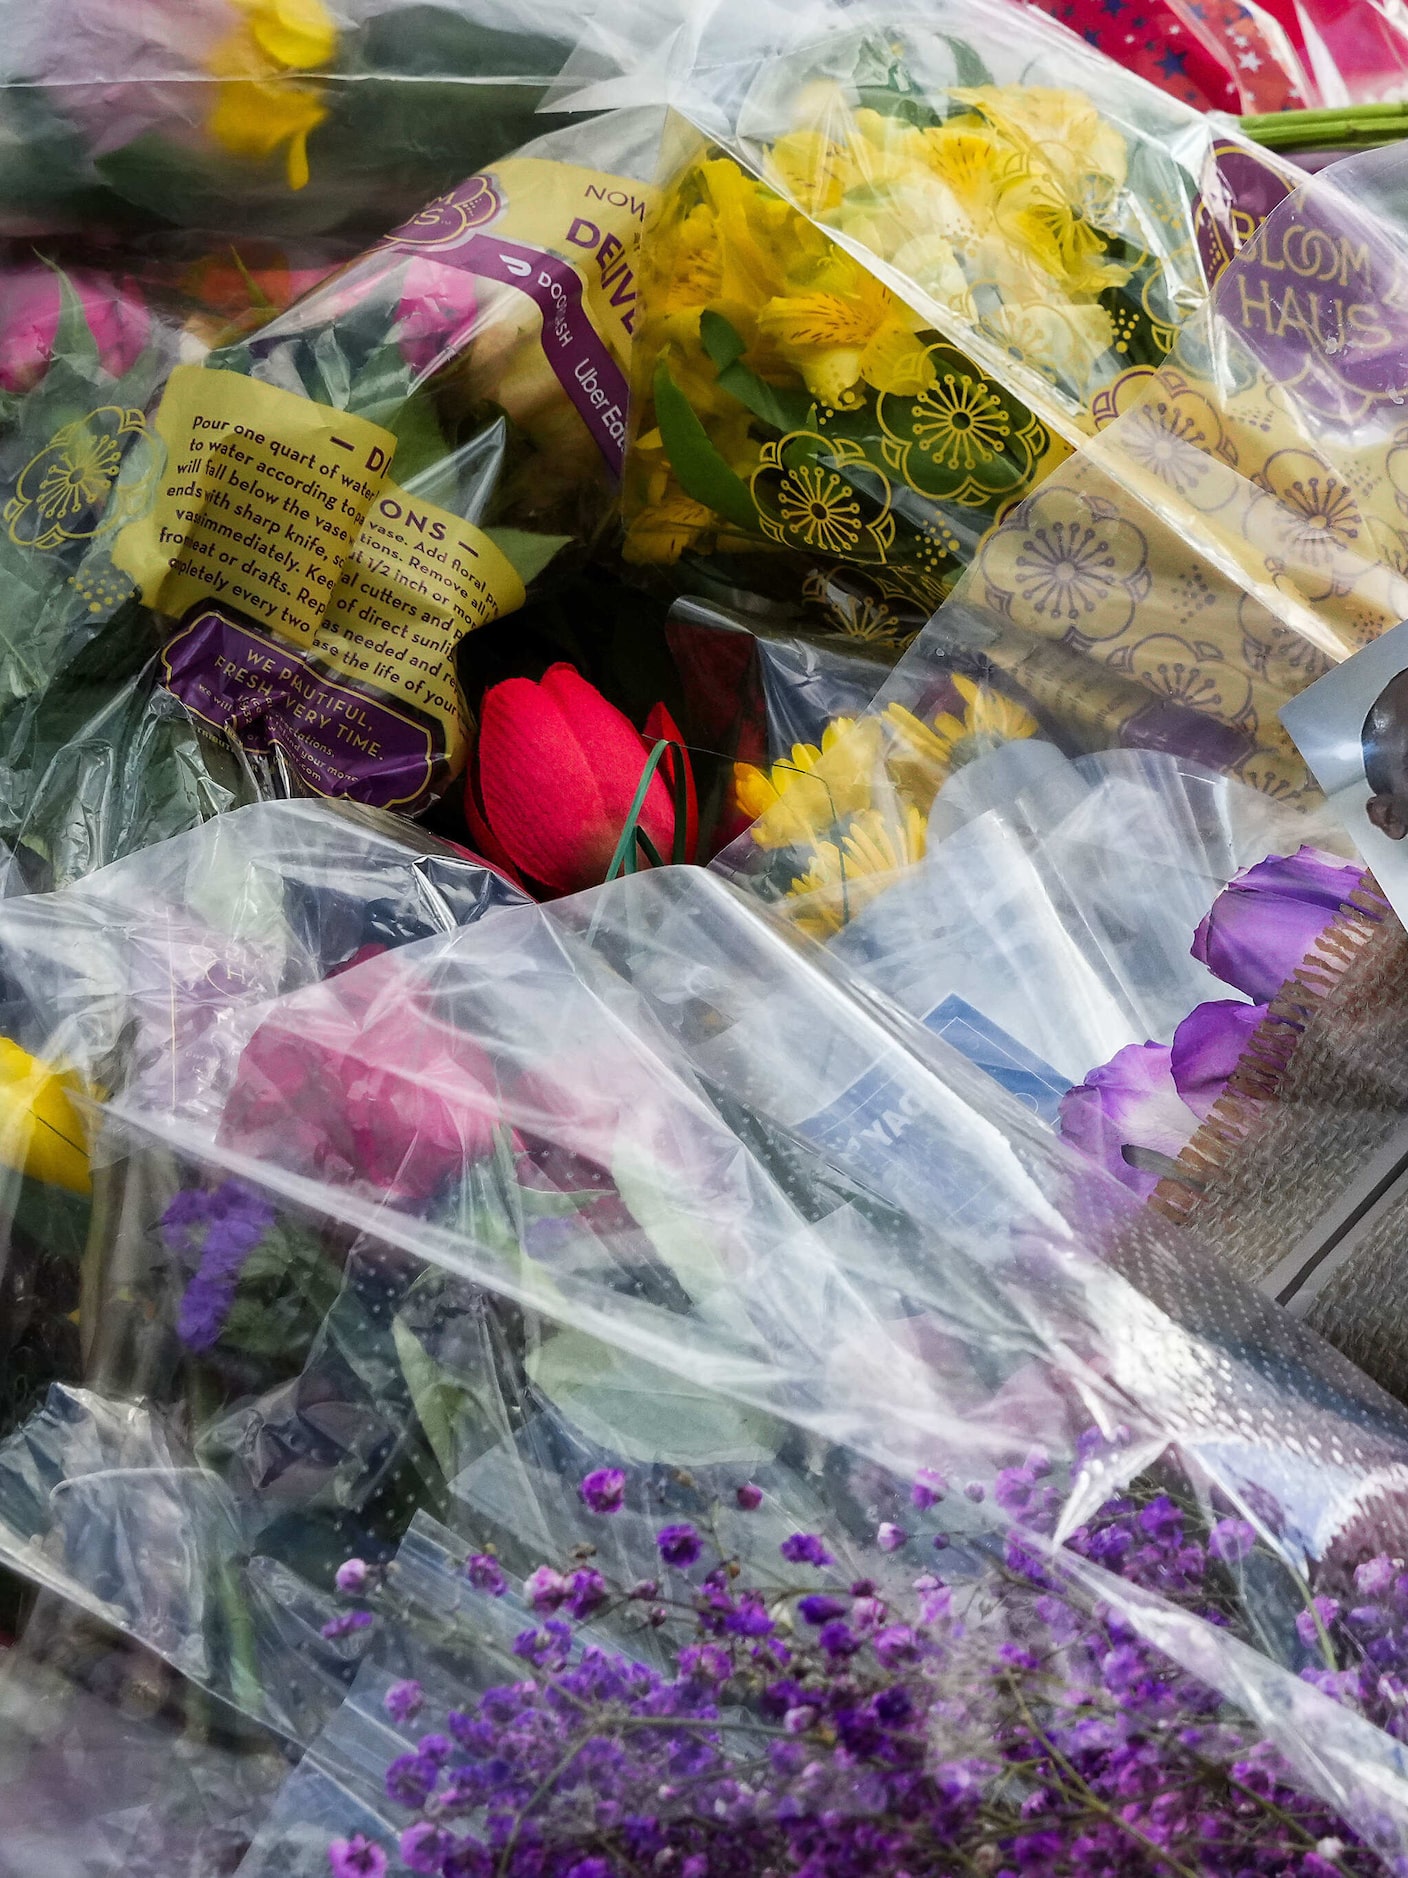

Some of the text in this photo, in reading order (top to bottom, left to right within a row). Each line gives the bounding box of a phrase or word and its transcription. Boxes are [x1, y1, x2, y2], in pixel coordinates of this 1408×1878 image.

[1231, 208, 1374, 293] BLOOM
[1236, 274, 1393, 352] HAUS
[574, 358, 610, 409] Uber
[166, 481, 202, 498] ends
[233, 504, 281, 535] sharp
[284, 524, 329, 561] knife,
[360, 582, 418, 617] cutters
[421, 611, 454, 632] and
[177, 459, 202, 474] will
[205, 460, 227, 480] fall
[228, 470, 279, 505] below
[282, 498, 310, 521] the
[315, 515, 348, 541] vase
[367, 557, 391, 577] 1/2
[394, 569, 428, 595] inch
[432, 592, 449, 605] or
[190, 438, 204, 451] to
[209, 442, 254, 465] water
[256, 461, 337, 510] according
[341, 497, 355, 517] to
[359, 533, 403, 562] tions.
[408, 556, 469, 599] Remove
[471, 598, 486, 617] all
[192, 416, 230, 430] Pour
[233, 425, 265, 444] one
[270, 440, 316, 469] quart
[319, 465, 341, 479] of
[341, 473, 374, 501] water
[369, 521, 408, 545] vase.
[413, 541, 448, 563] Add
[451, 560, 487, 593] floral
[379, 498, 447, 541] ONS
[200, 512, 300, 573] immediately.
[336, 598, 358, 612] of
[358, 606, 409, 639] direct
[219, 550, 238, 565] or
[241, 560, 292, 596] drafts.
[321, 617, 339, 633] as
[342, 629, 409, 661] needed
[409, 656, 443, 677] and
[232, 583, 279, 616] every
[281, 607, 311, 633] two
[342, 652, 370, 672] the
[372, 662, 401, 684] life
[405, 680, 426, 695] of
[425, 689, 458, 715] your
[246, 649, 277, 674] WE
[214, 655, 273, 697] FRESH
[280, 689, 332, 730] VERY
[338, 726, 385, 761] TIME.
[301, 750, 327, 768] your
